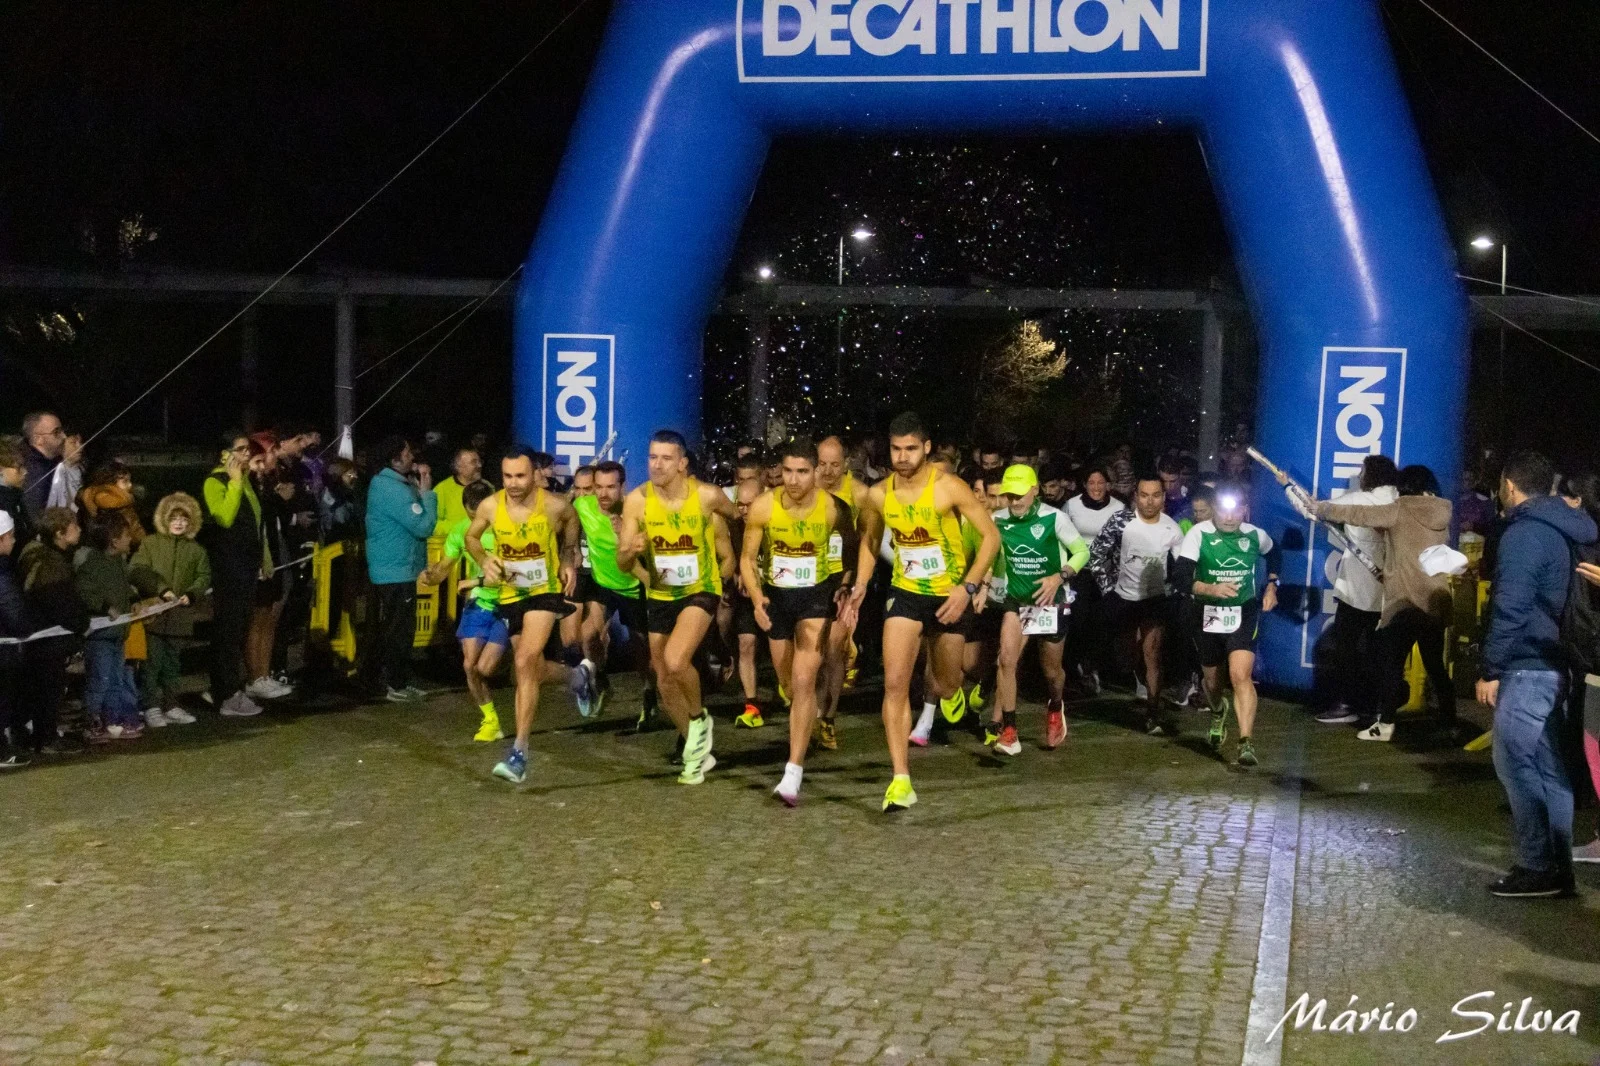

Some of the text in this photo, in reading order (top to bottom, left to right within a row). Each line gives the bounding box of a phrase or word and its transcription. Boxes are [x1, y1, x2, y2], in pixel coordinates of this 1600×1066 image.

[761, 0, 1180, 57] DECATHLON
[922, 557, 939, 570] 88
[527, 569, 542, 581] 89
[677, 566, 693, 578] 84
[795, 567, 811, 579] 90
[1038, 616, 1053, 627] 65
[1223, 615, 1236, 627] 98
